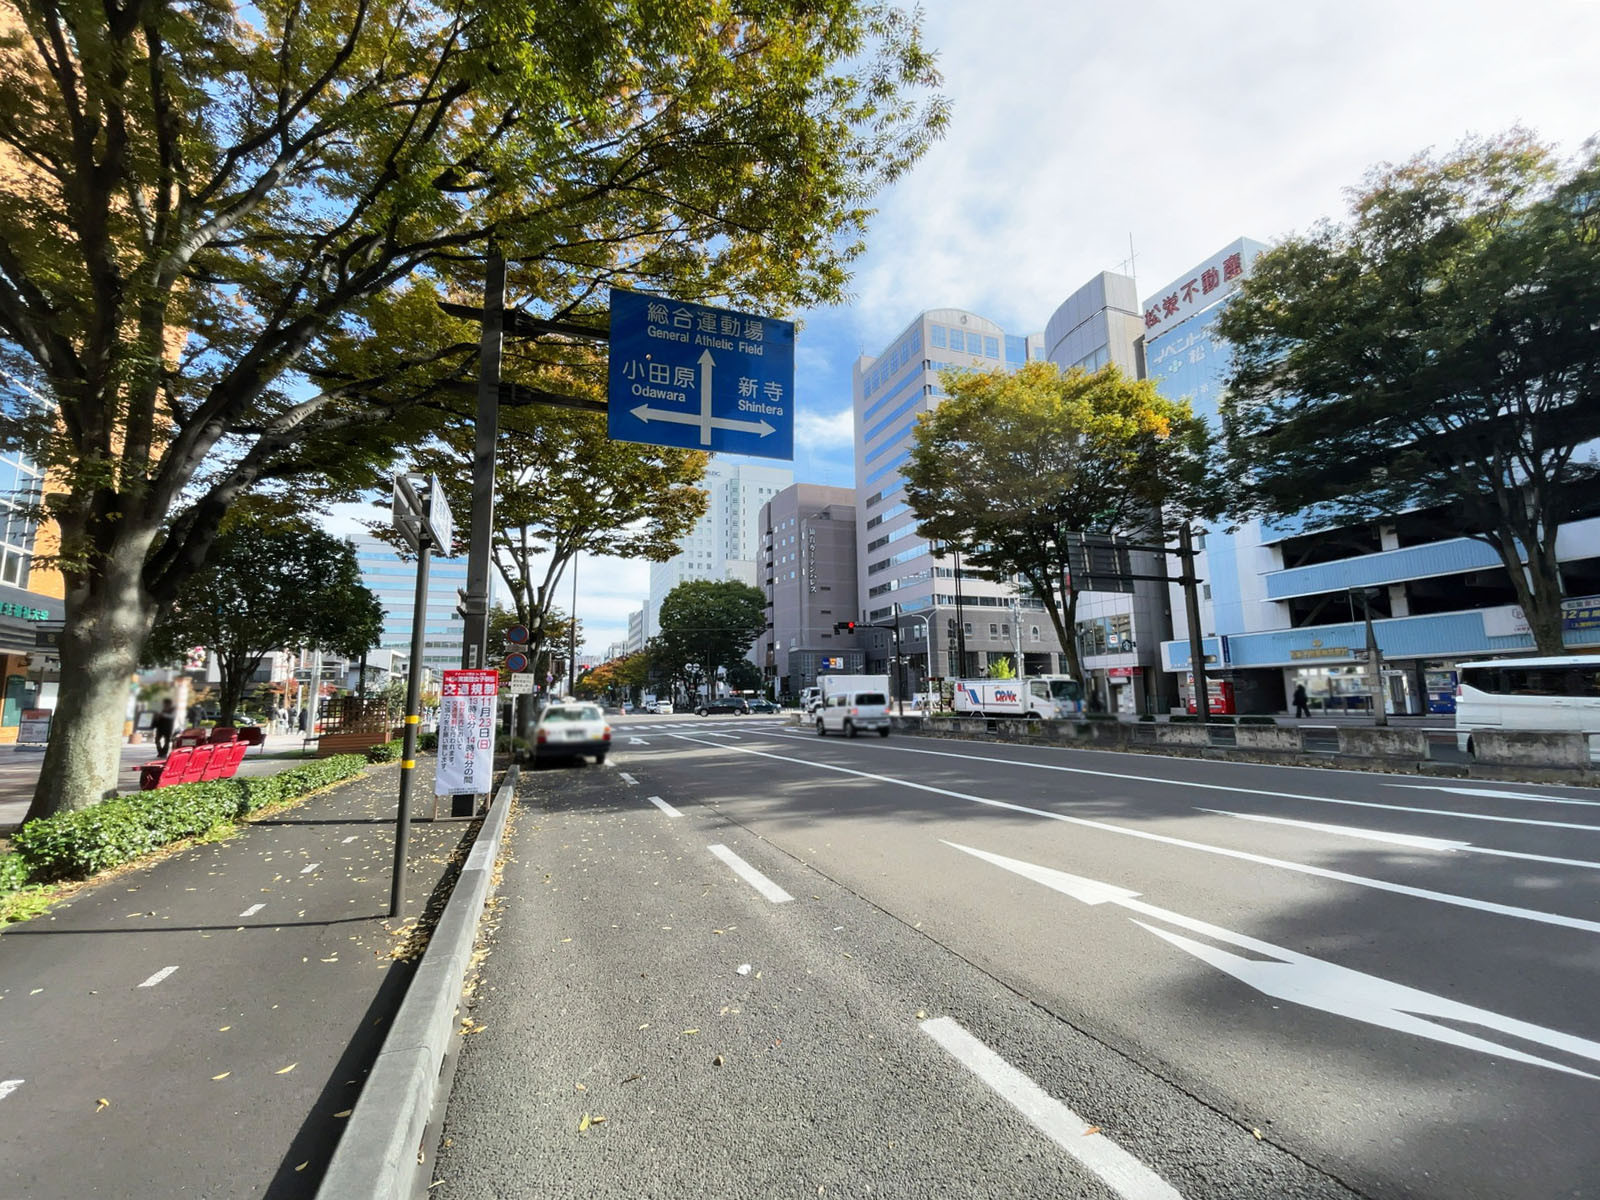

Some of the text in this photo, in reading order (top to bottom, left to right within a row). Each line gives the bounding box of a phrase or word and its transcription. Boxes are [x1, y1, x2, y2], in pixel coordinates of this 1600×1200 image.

[647, 301, 764, 342] 総合運動場
[647, 325, 763, 356] General Athletic Field
[622, 359, 696, 389] 小田原
[631, 384, 686, 402] Odawara
[738, 376, 784, 402] 新寺
[738, 400, 784, 416] Shintera
[444, 683, 496, 696] 交通規制
